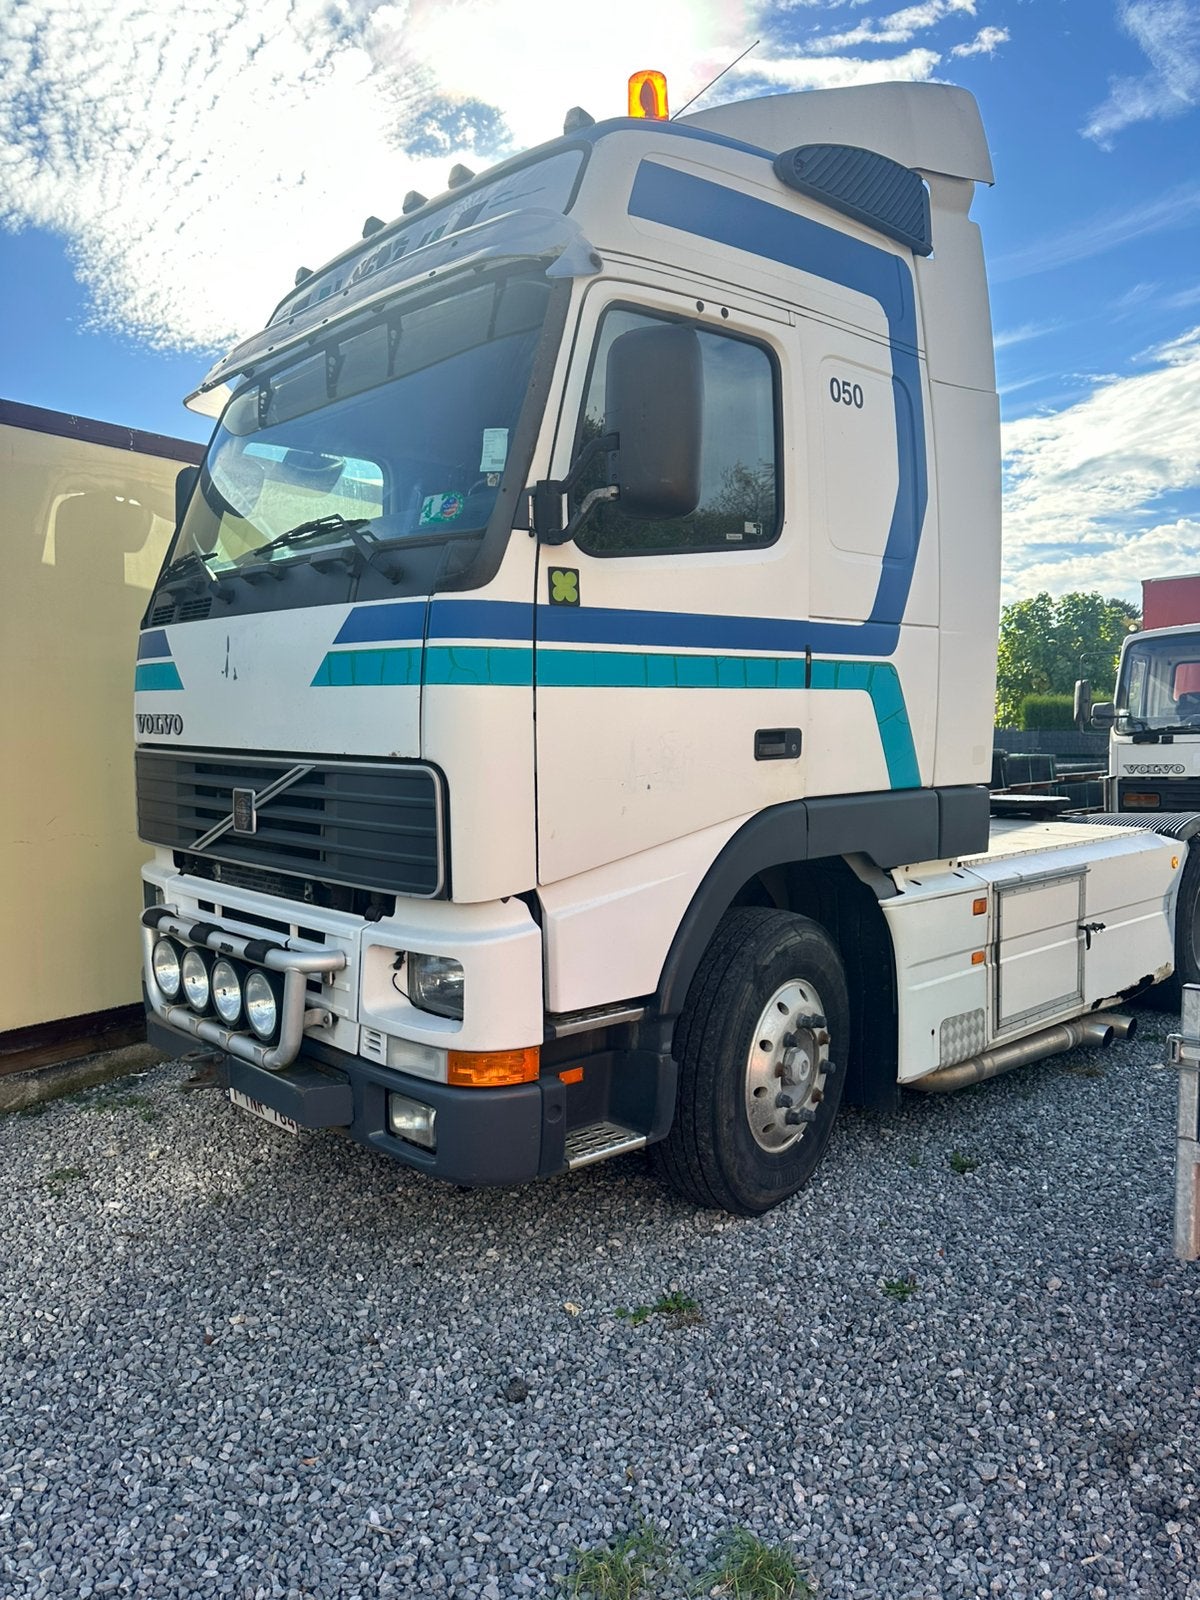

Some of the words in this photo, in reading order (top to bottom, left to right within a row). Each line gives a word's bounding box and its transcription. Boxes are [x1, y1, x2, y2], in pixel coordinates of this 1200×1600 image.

[829, 376, 864, 409] 050
[135, 713, 183, 735] VOLVO
[1122, 763, 1185, 774] VOLVO
